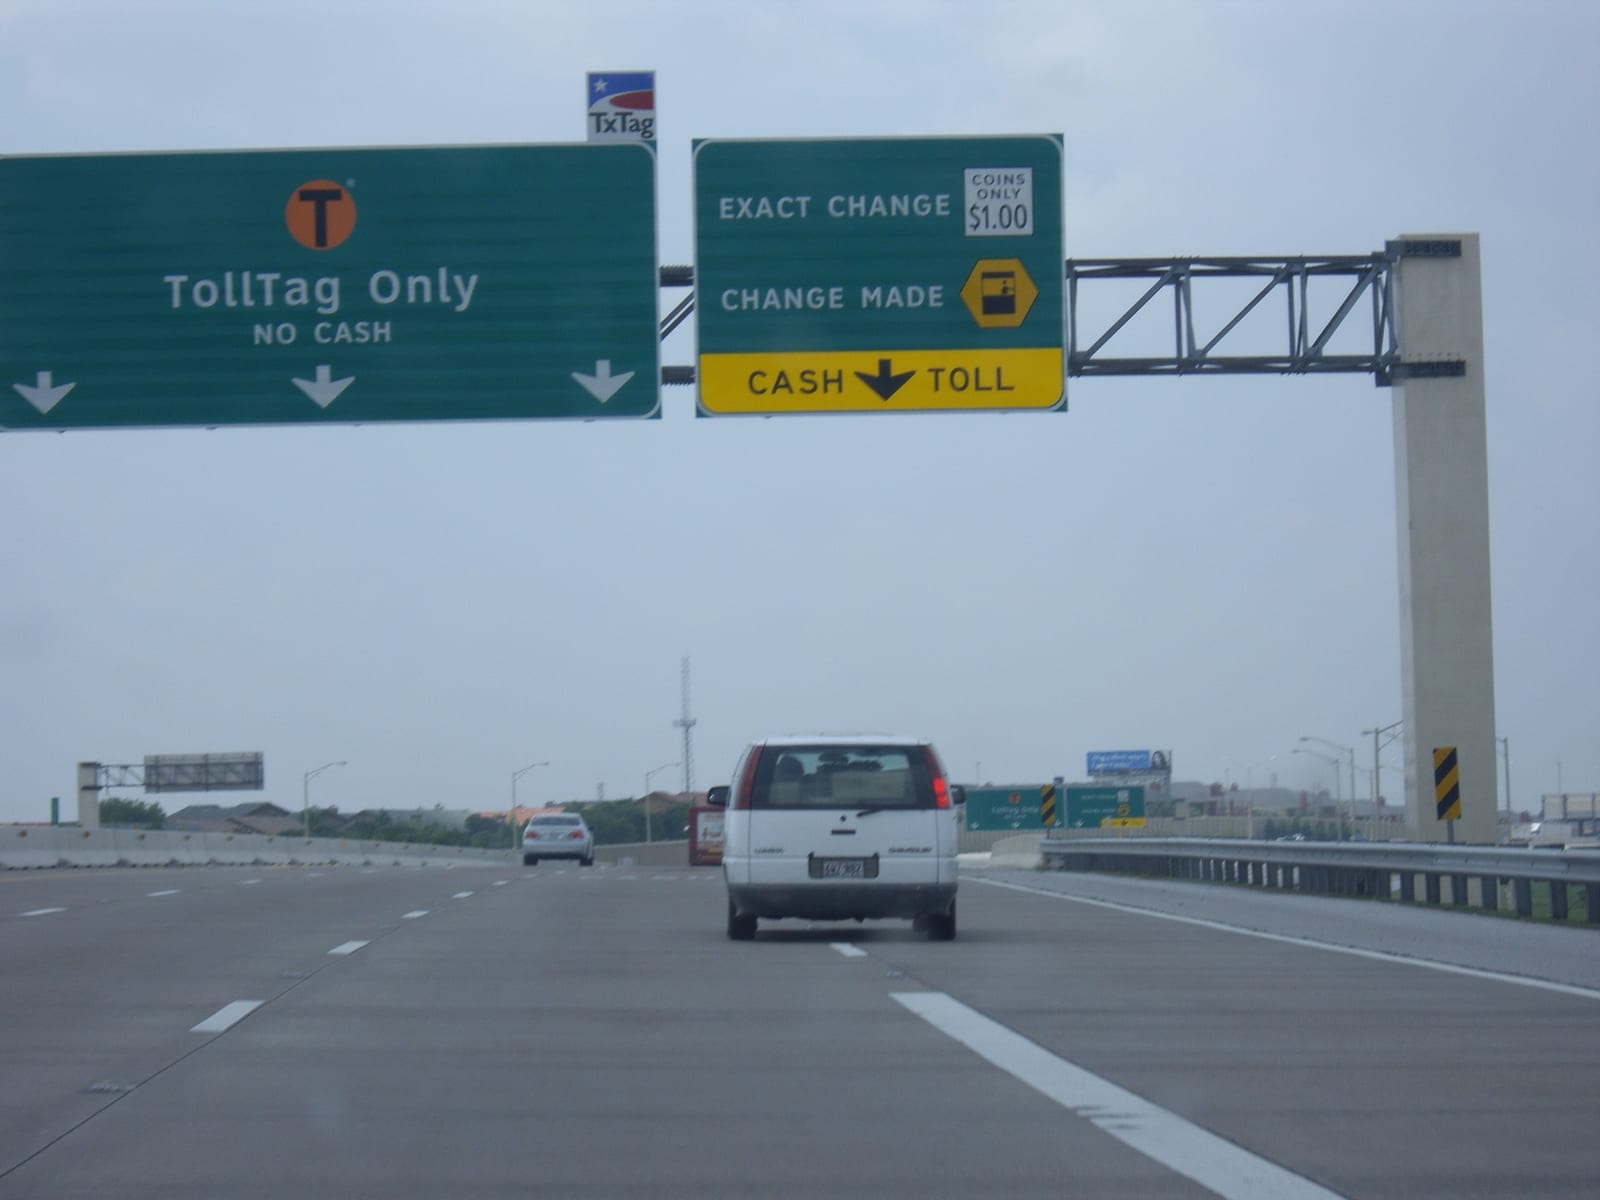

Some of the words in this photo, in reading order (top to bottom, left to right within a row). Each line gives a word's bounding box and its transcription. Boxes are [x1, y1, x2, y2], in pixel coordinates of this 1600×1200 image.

[588, 111, 654, 139] TxTag
[972, 174, 1025, 186] COINS
[719, 196, 811, 220] EXACT
[827, 193, 951, 217] CHANGE
[977, 188, 1021, 200] ONLY
[969, 203, 1028, 231] $1.00
[163, 271, 341, 315] TollTag
[368, 266, 479, 312] Only
[721, 287, 844, 311] CHANGE
[861, 285, 944, 308] MADE
[253, 323, 297, 345] NO
[313, 321, 393, 344] CASH
[748, 369, 844, 396] CASH
[927, 366, 1015, 392] TOLL
